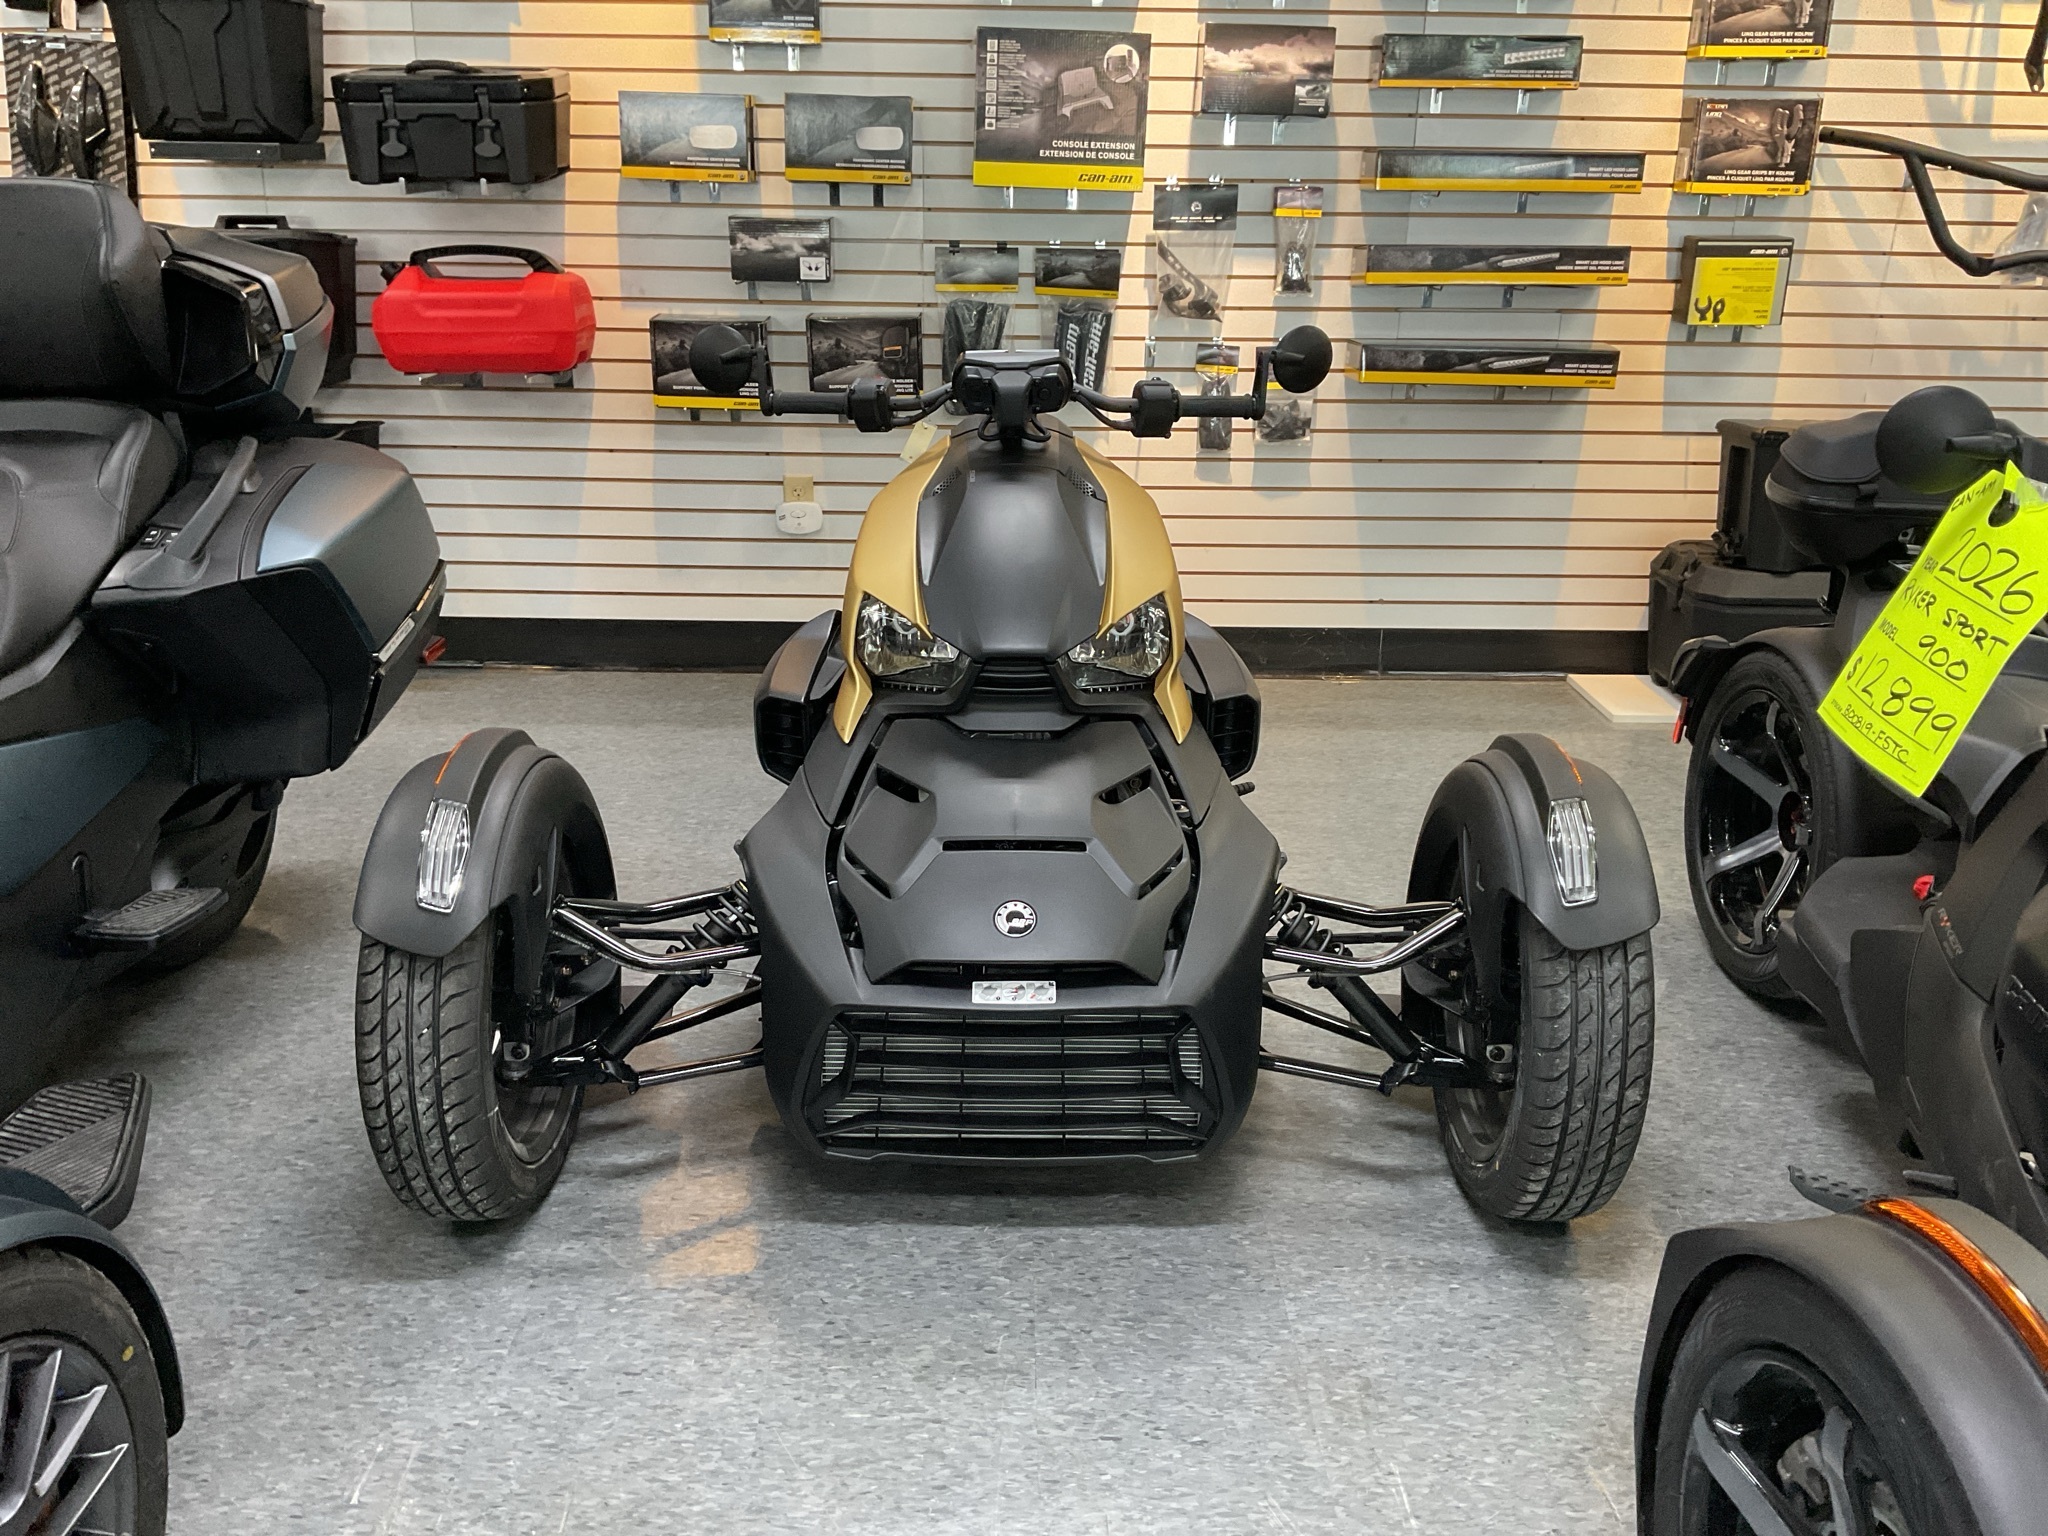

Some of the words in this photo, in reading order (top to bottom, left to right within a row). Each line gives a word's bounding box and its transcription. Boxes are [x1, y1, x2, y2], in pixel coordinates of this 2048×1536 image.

[1039, 150, 1084, 158] EXTENSION
[1085, 151, 1096, 159] DE
[1097, 152, 1135, 160] CONSOLE
[1052, 140, 1089, 149] CONSOLE
[1090, 141, 1135, 150] EXTENSION
[1078, 173, 1133, 184] can-am
[1083, 314, 1105, 390] can-am
[1940, 528, 2039, 615] 2026
[1901, 578, 1937, 618] RYKER
[1942, 608, 2010, 656] SPORT
[1879, 618, 1899, 642] MODEL
[1919, 635, 1969, 681] 900
